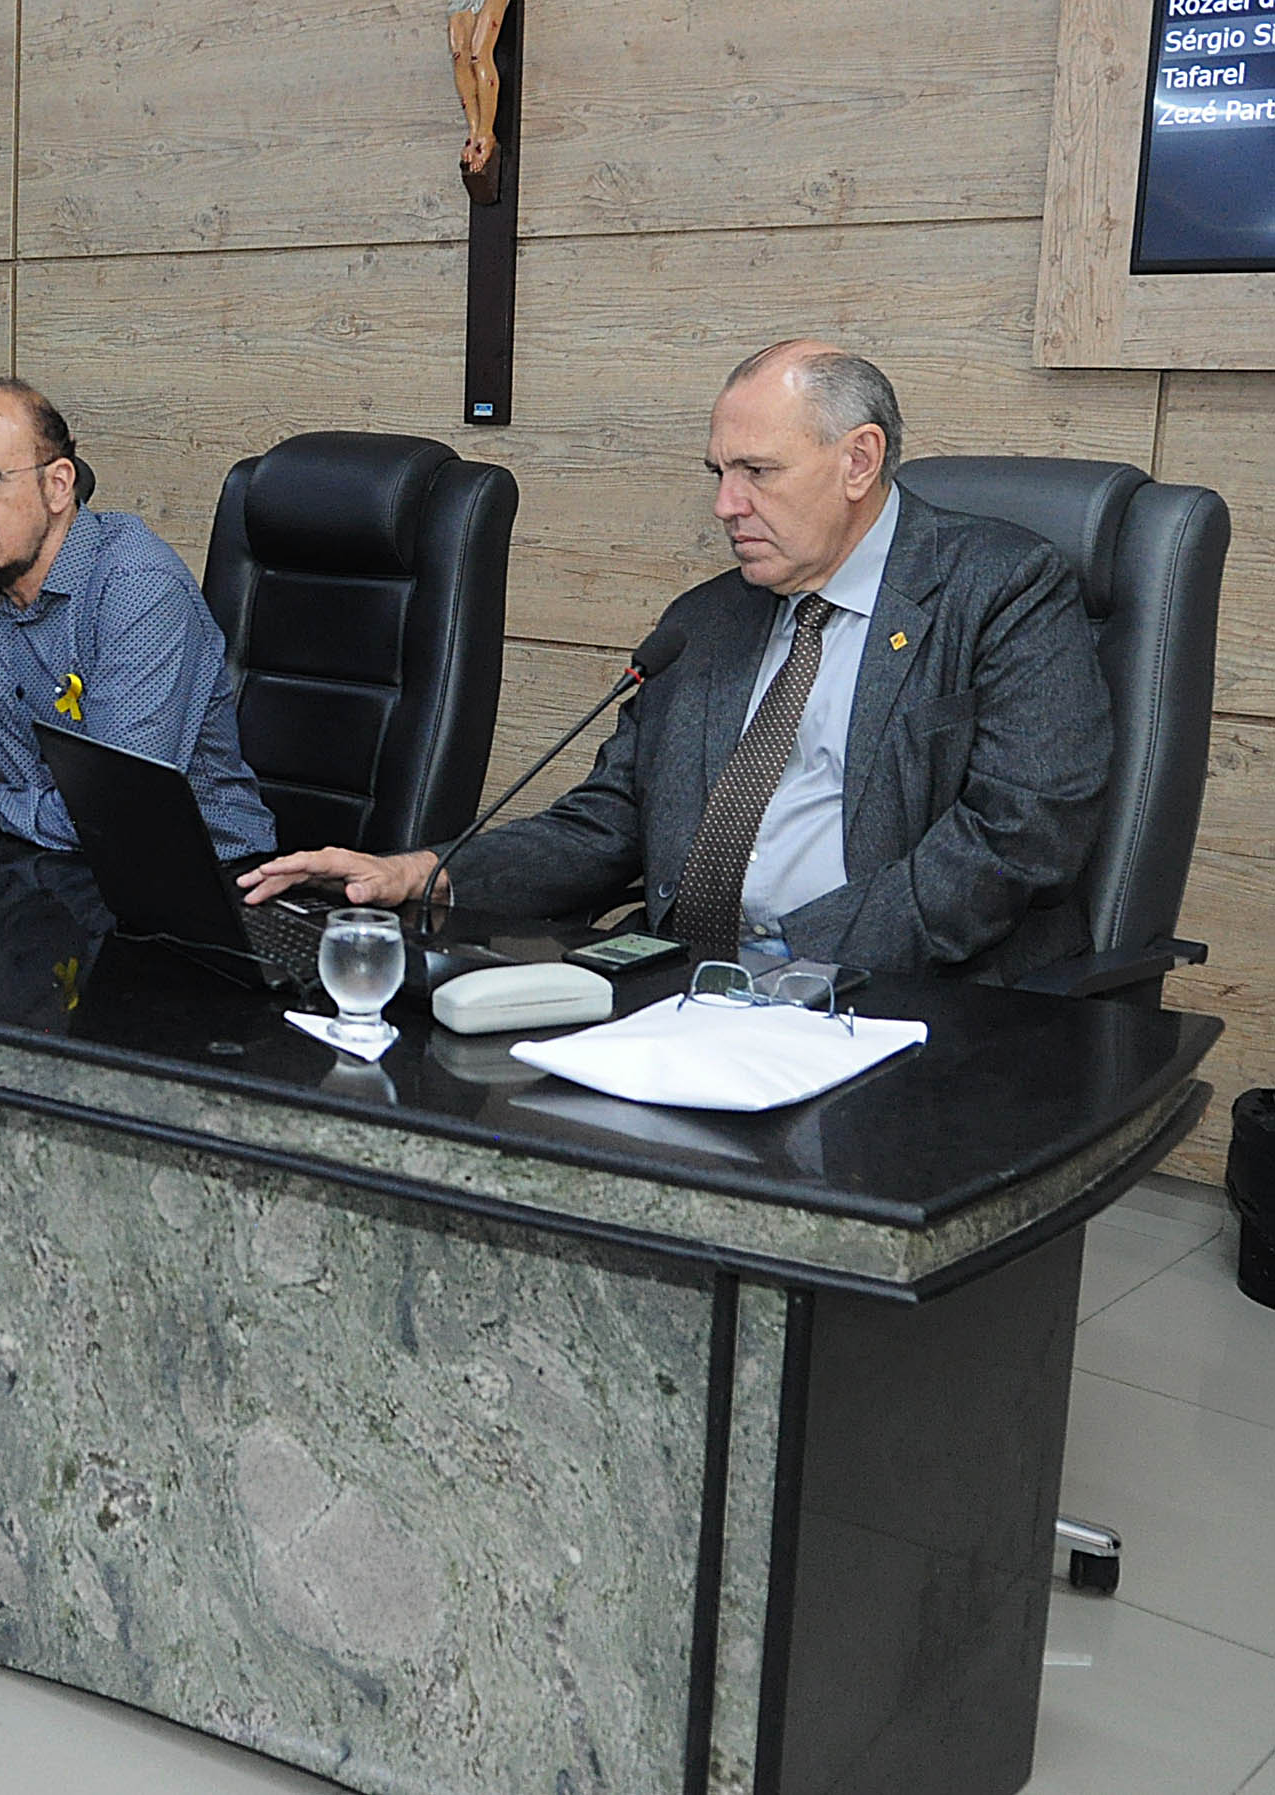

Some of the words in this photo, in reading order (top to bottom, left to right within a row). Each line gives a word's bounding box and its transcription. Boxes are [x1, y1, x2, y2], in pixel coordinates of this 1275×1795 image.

[1164, 28, 1245, 55] Sérgio
[1162, 62, 1246, 89] Tafarel
[1158, 99, 1217, 126] Zezé
